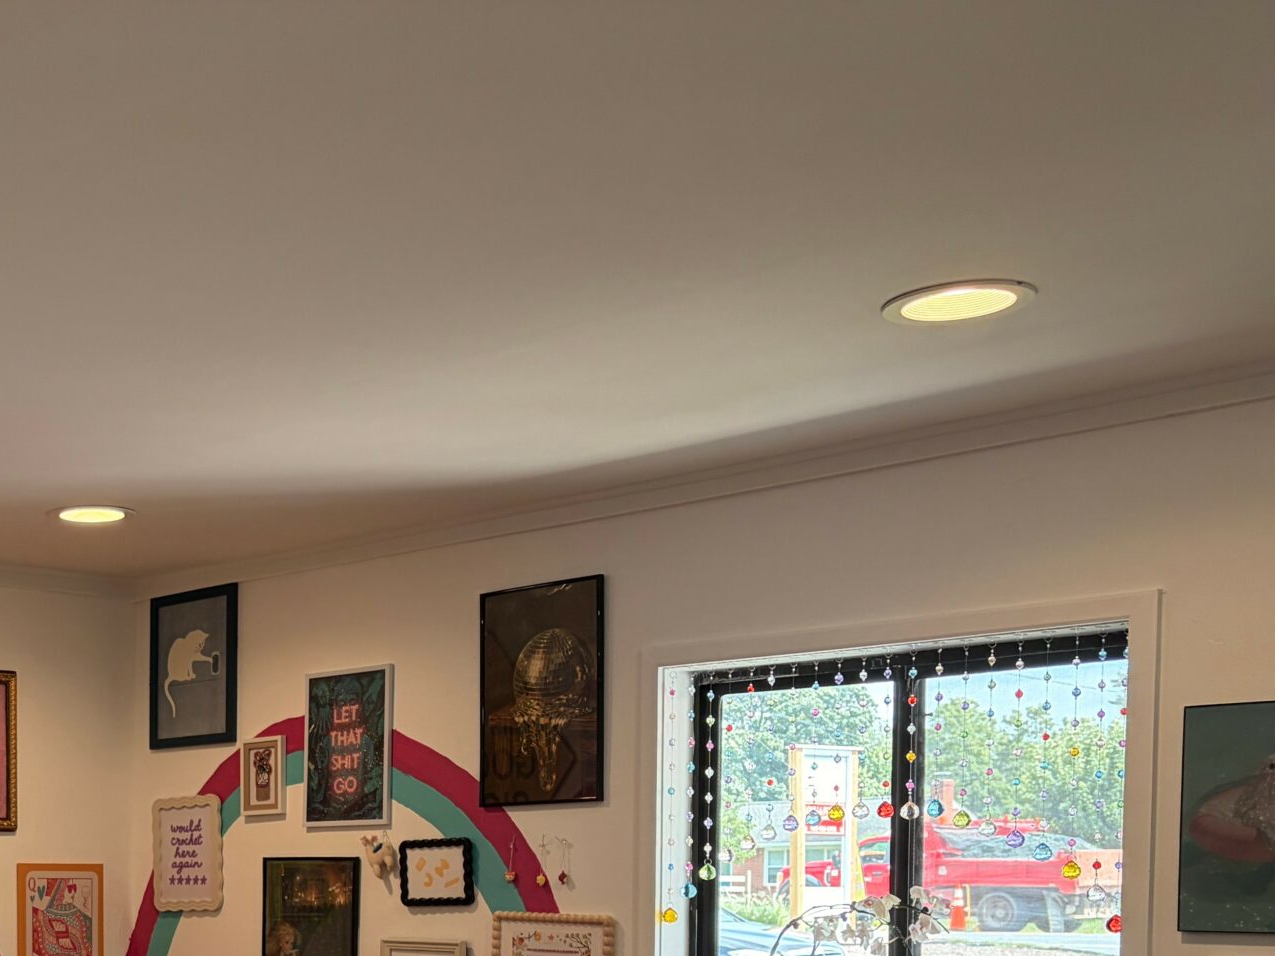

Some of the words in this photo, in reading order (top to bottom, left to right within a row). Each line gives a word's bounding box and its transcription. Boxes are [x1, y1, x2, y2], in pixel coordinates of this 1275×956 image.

[333, 703, 359, 723] LET
[330, 728, 363, 746] THAT
[331, 752, 360, 771] SHIT
[333, 776, 357, 794] GO
[170, 818, 202, 833] would
[170, 833, 203, 846] crochet
[174, 847, 198, 859] here
[171, 859, 203, 875] again
[28, 877, 36, 892] Q
